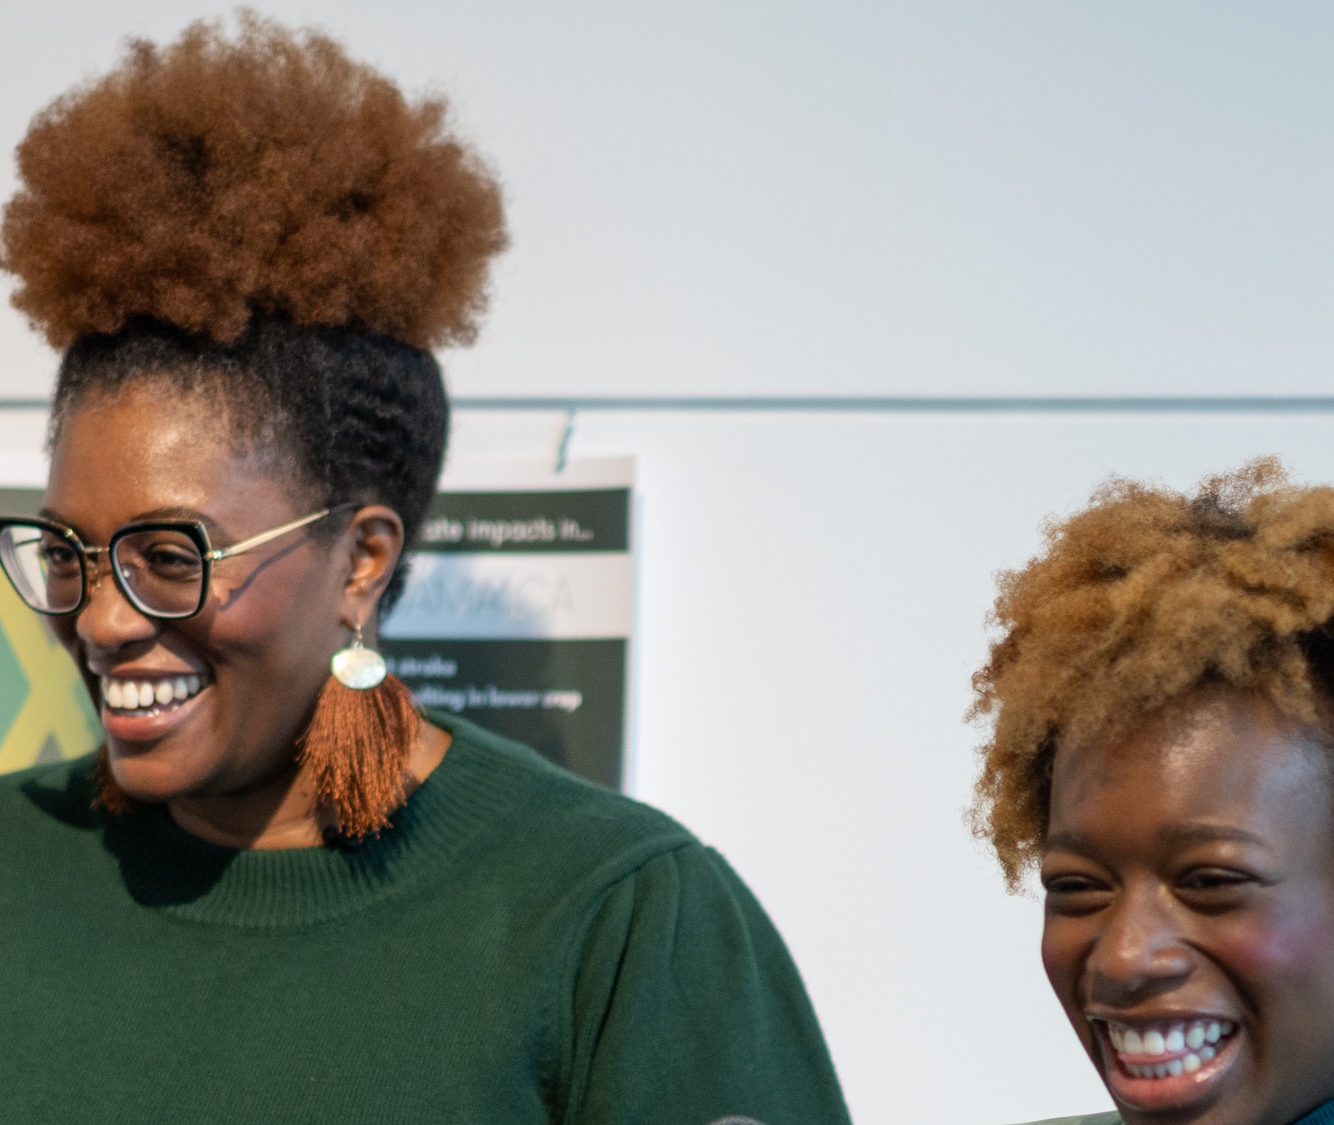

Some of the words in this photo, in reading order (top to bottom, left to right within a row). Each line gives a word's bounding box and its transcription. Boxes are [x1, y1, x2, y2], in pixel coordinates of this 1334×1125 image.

[422, 517, 463, 542] ate
[468, 516, 555, 547] impacts
[559, 516, 594, 541] in...
[408, 577, 578, 618] AMAICA
[487, 684, 540, 708] lower
